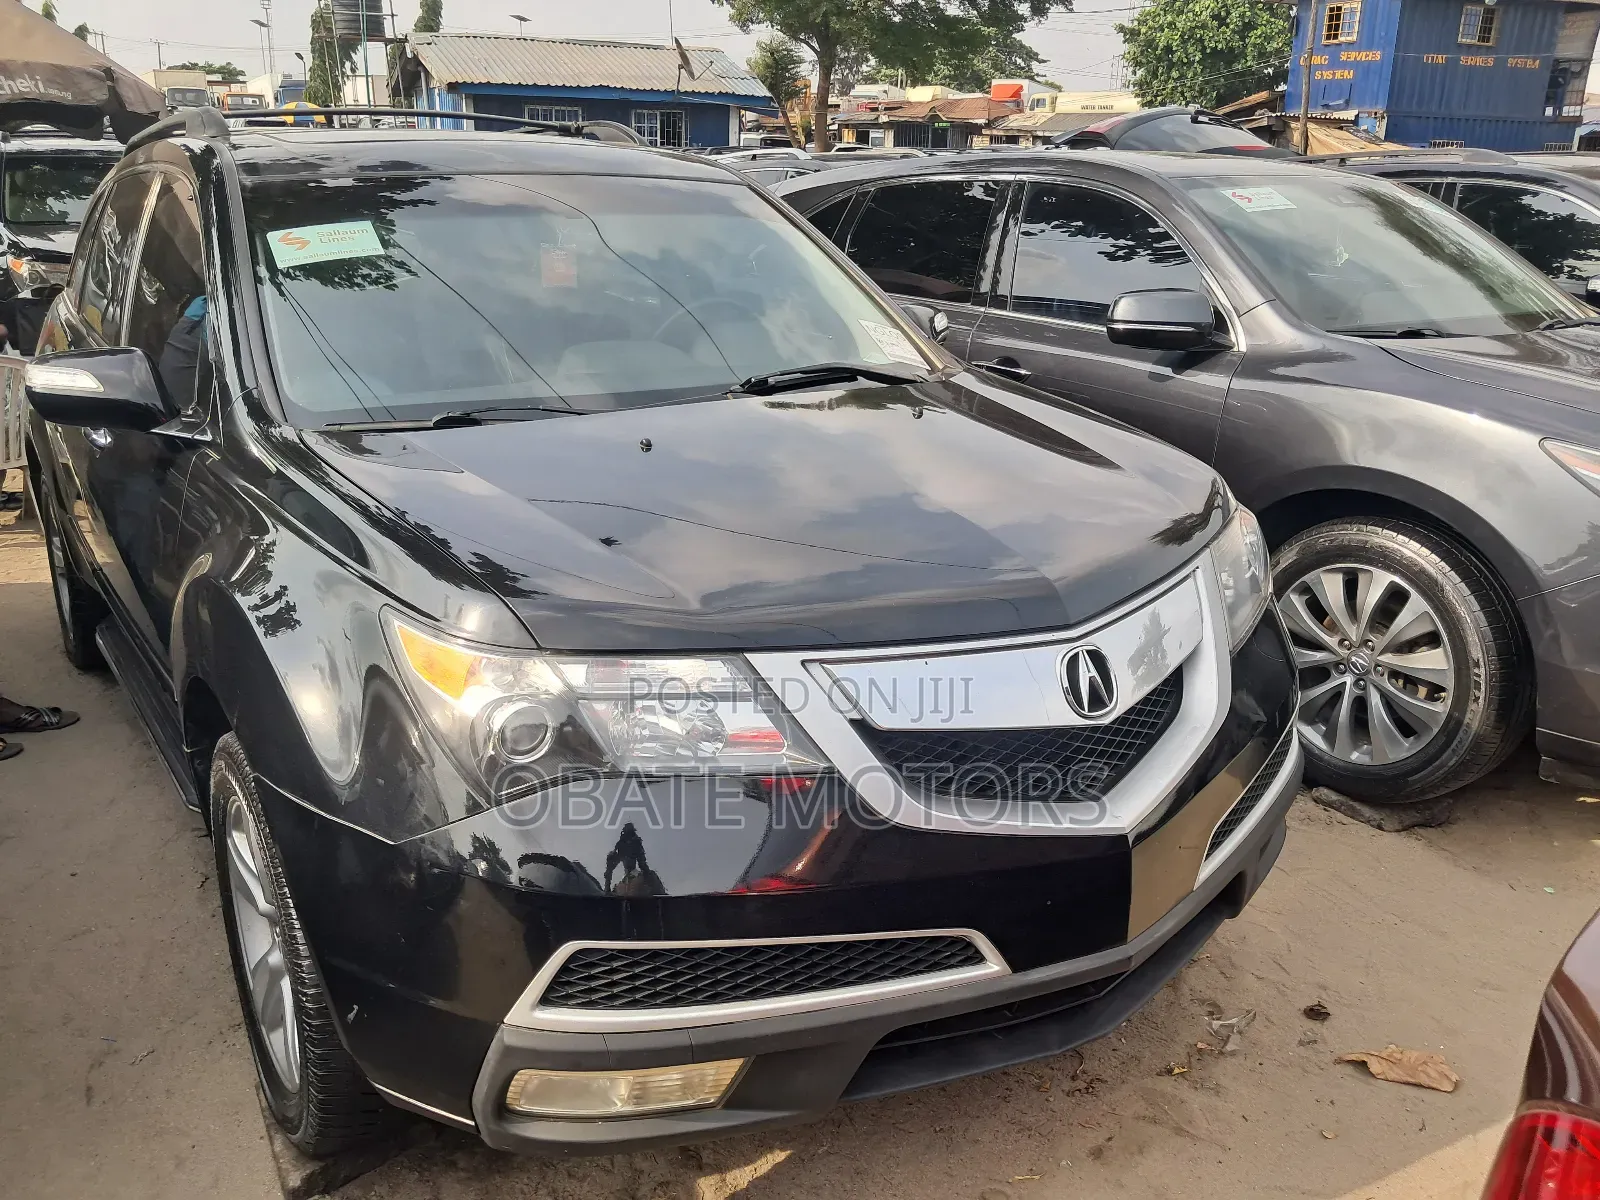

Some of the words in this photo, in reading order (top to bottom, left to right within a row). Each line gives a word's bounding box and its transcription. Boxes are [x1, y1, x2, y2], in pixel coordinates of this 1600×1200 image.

[1339, 51, 1381, 61] SERVICES
[1314, 69, 1354, 80] SYSTEM
[316, 228, 369, 238] Sallaum
[320, 236, 355, 244] Lines
[280, 247, 380, 263] www.sallaumlines.com
